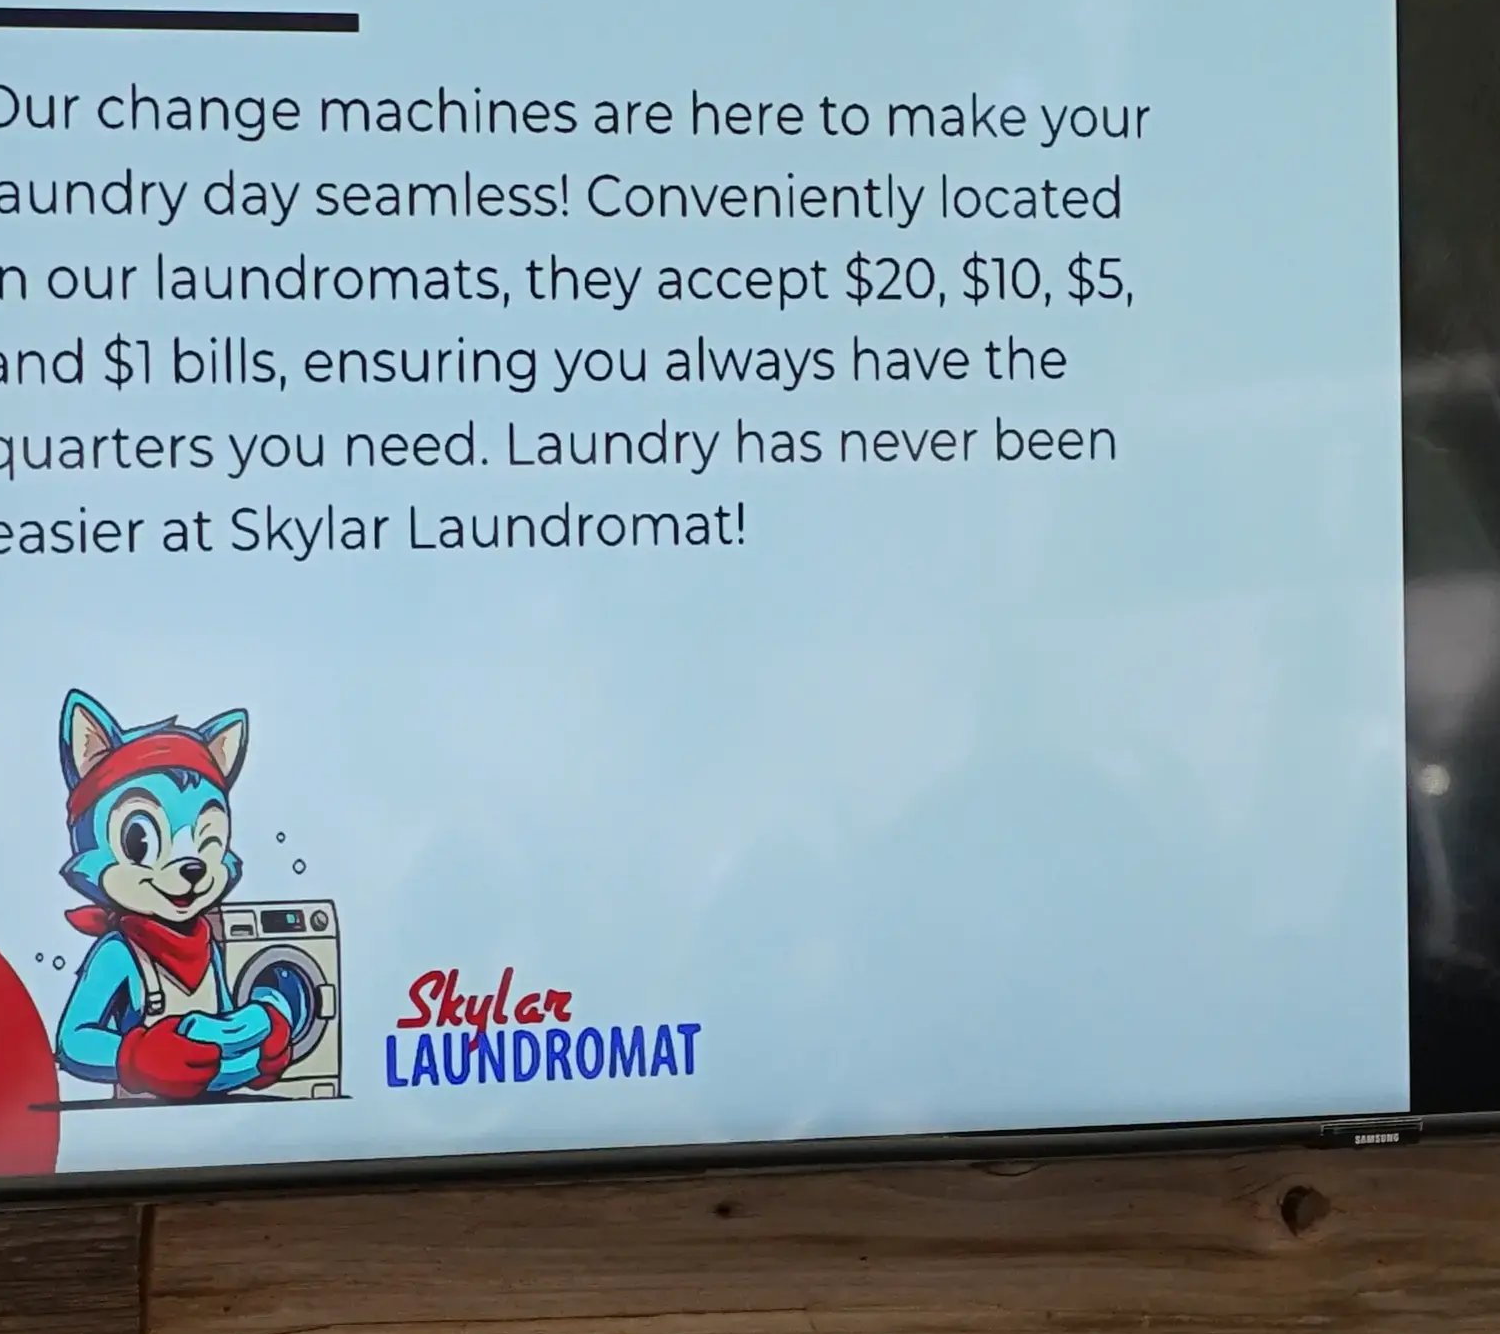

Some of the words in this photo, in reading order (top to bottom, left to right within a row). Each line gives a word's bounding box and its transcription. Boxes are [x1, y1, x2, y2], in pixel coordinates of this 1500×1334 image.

[98, 83, 300, 141] change
[322, 86, 577, 133] machines
[595, 101, 672, 134] are
[693, 89, 803, 135] here
[820, 96, 869, 135] to
[889, 93, 1026, 137] make
[1041, 106, 1150, 147] your
[204, 169, 299, 226] day
[317, 171, 568, 216] seamless!
[588, 173, 924, 228] Conveniently
[943, 174, 1120, 218] located
[48, 266, 136, 299] our
[158, 253, 509, 308] laundromats,
[526, 254, 641, 310] they
[659, 261, 828, 311] accept
[846, 251, 945, 307] $20,
[963, 251, 1051, 307] $10,
[1068, 252, 1132, 307] $5,
[105, 333, 152, 390] $1
[174, 337, 286, 391] bills,
[305, 337, 535, 393] ensuring
[554, 349, 645, 392] you
[667, 336, 834, 391] always
[854, 336, 969, 380] have
[985, 335, 1066, 380] the
[228, 435, 323, 479] you
[348, 420, 487, 466] need.
[509, 419, 719, 474] Laundry
[738, 419, 821, 463] has
[842, 430, 977, 462] never
[997, 417, 1115, 460] been
[163, 511, 212, 552] at
[232, 504, 389, 561] Skylar
[411, 502, 744, 549] Laundromat!
[397, 967, 573, 1049] Skylar
[385, 1023, 702, 1088] LAUNDROMAT
[1355, 1133, 1399, 1145] SAMSUNG
